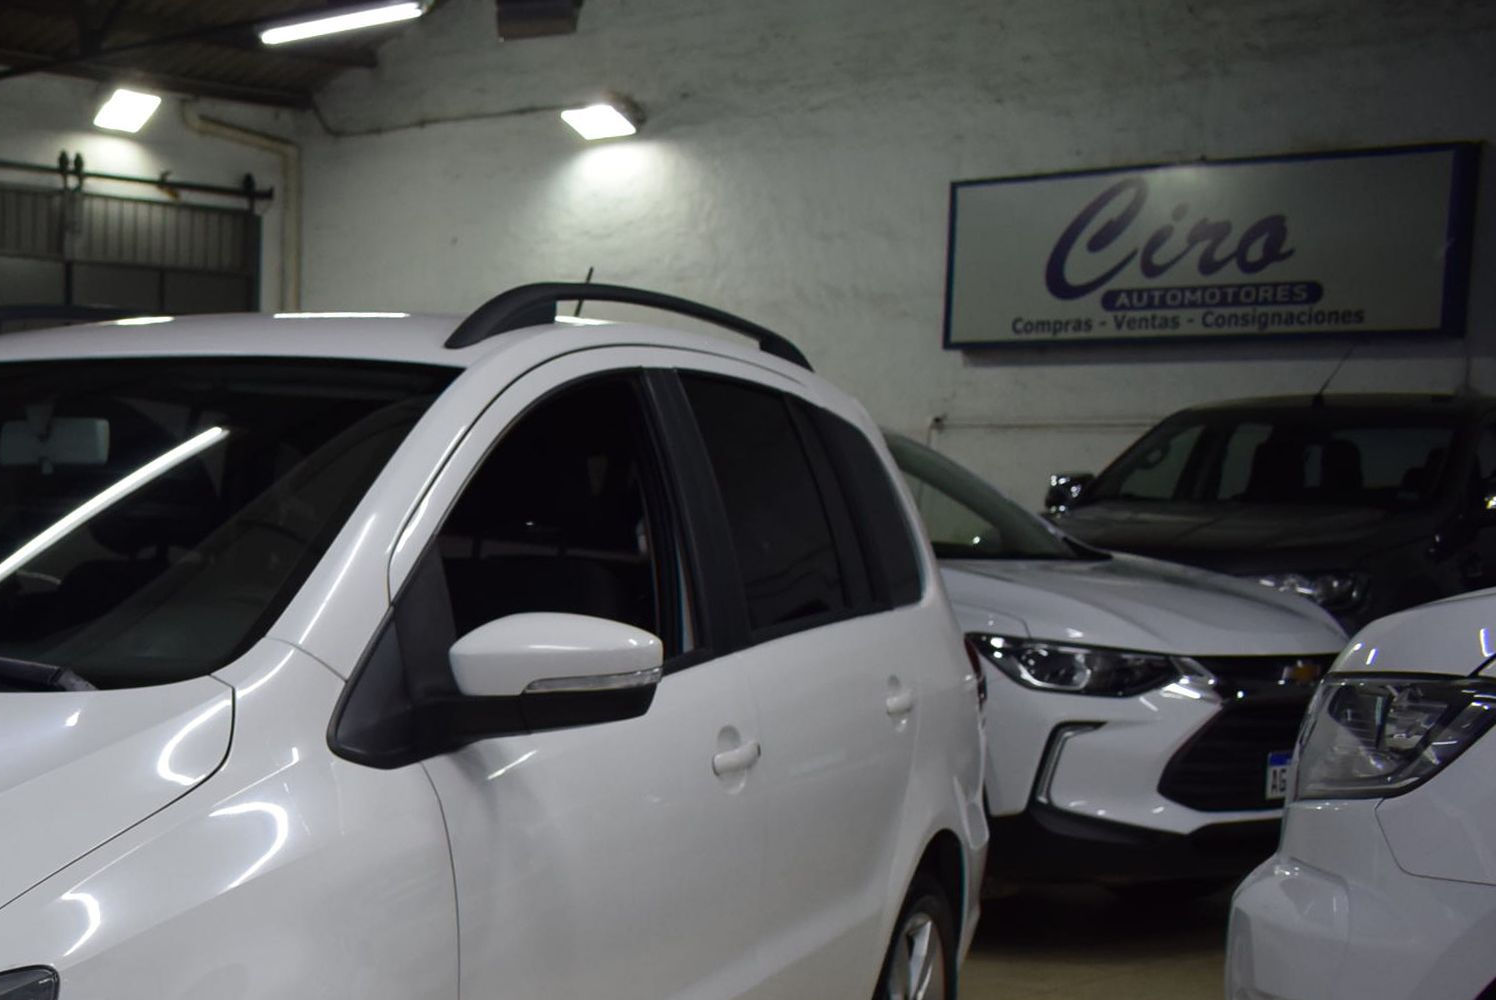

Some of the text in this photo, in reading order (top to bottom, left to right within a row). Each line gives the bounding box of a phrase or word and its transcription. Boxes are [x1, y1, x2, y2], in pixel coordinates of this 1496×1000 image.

[1045, 177, 1295, 299] Ciro
[1115, 284, 1309, 307] AUTOMOTORES
[1011, 316, 1093, 336] Compras
[1114, 312, 1181, 331] Ventas
[1201, 306, 1365, 330] Consignaciones
